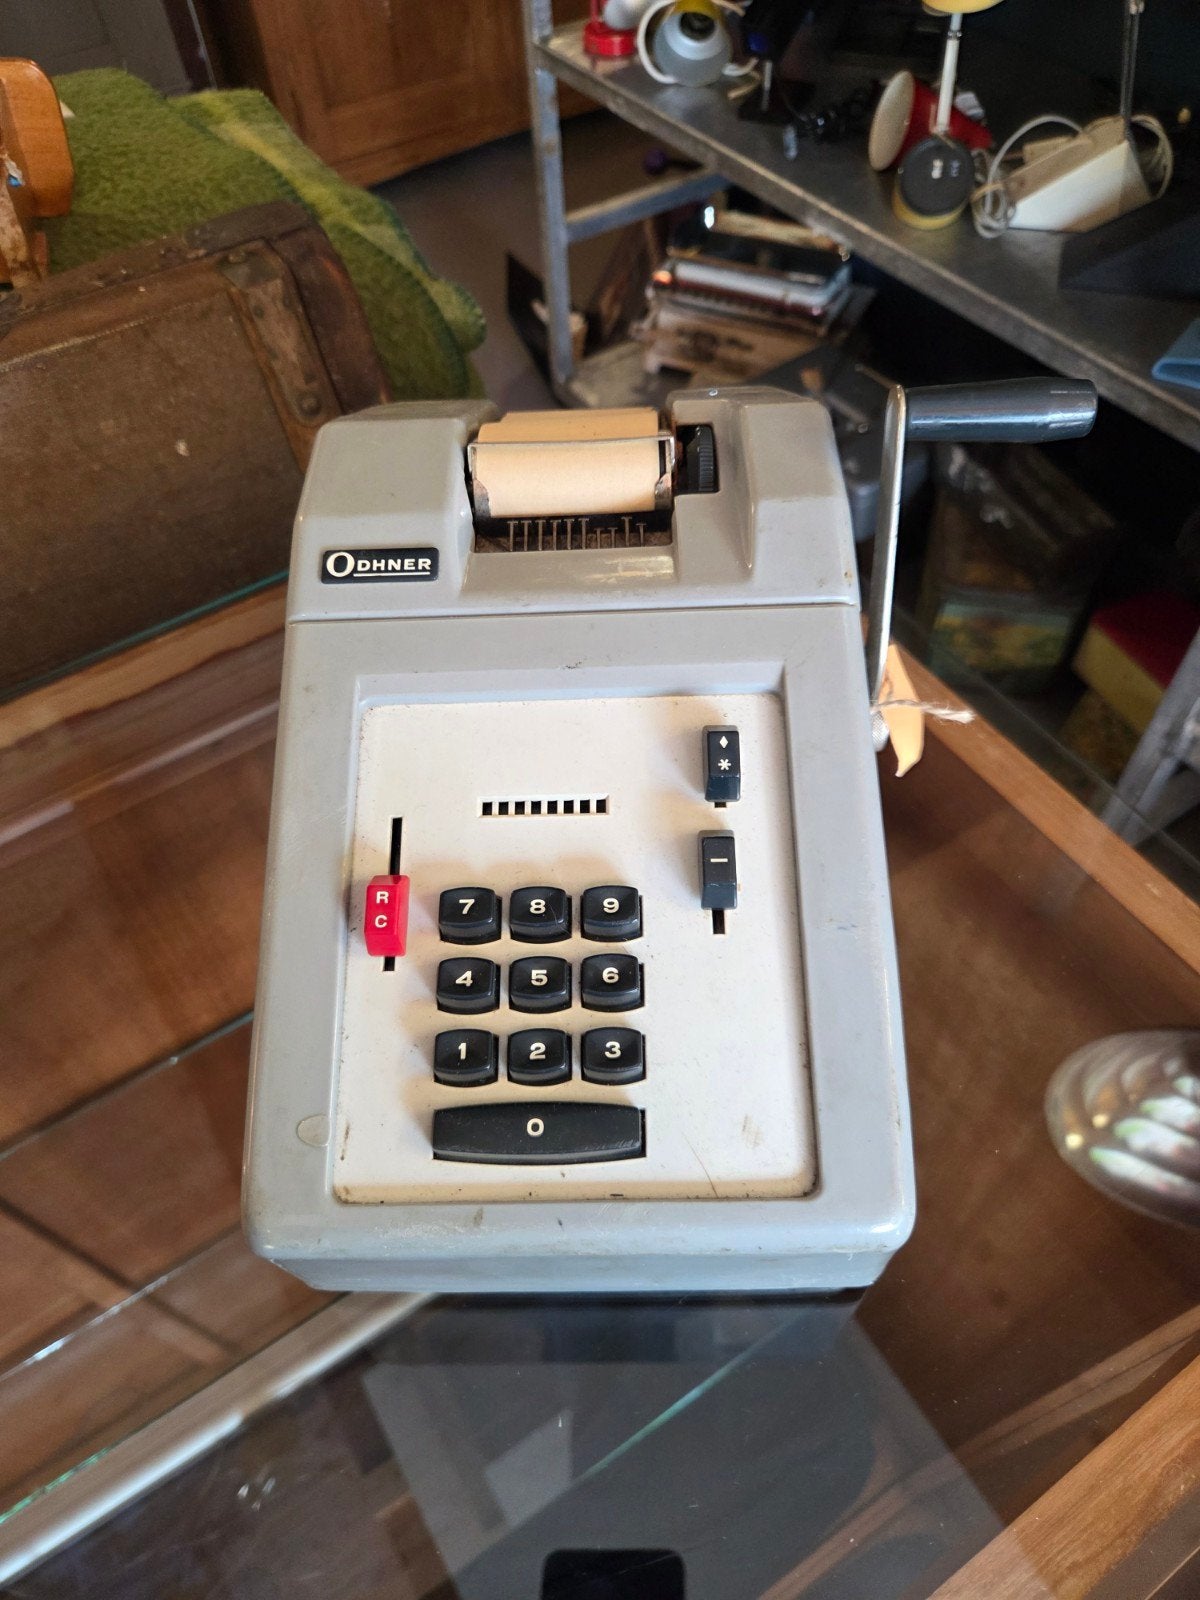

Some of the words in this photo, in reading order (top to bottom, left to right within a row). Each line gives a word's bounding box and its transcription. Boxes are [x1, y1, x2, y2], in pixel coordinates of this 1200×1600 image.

[326, 551, 432, 578] ODHNER
[375, 890, 389, 904] R
[458, 898, 475, 915] 7
[529, 898, 546, 914] 8
[602, 897, 620, 914] 9
[374, 914, 388, 929] C
[455, 970, 473, 987] 4
[531, 969, 548, 986] 5
[602, 967, 619, 983] 6
[458, 1042, 467, 1060] 1
[529, 1042, 546, 1060] 2
[604, 1041, 621, 1058] 3
[526, 1118, 545, 1137] 0
